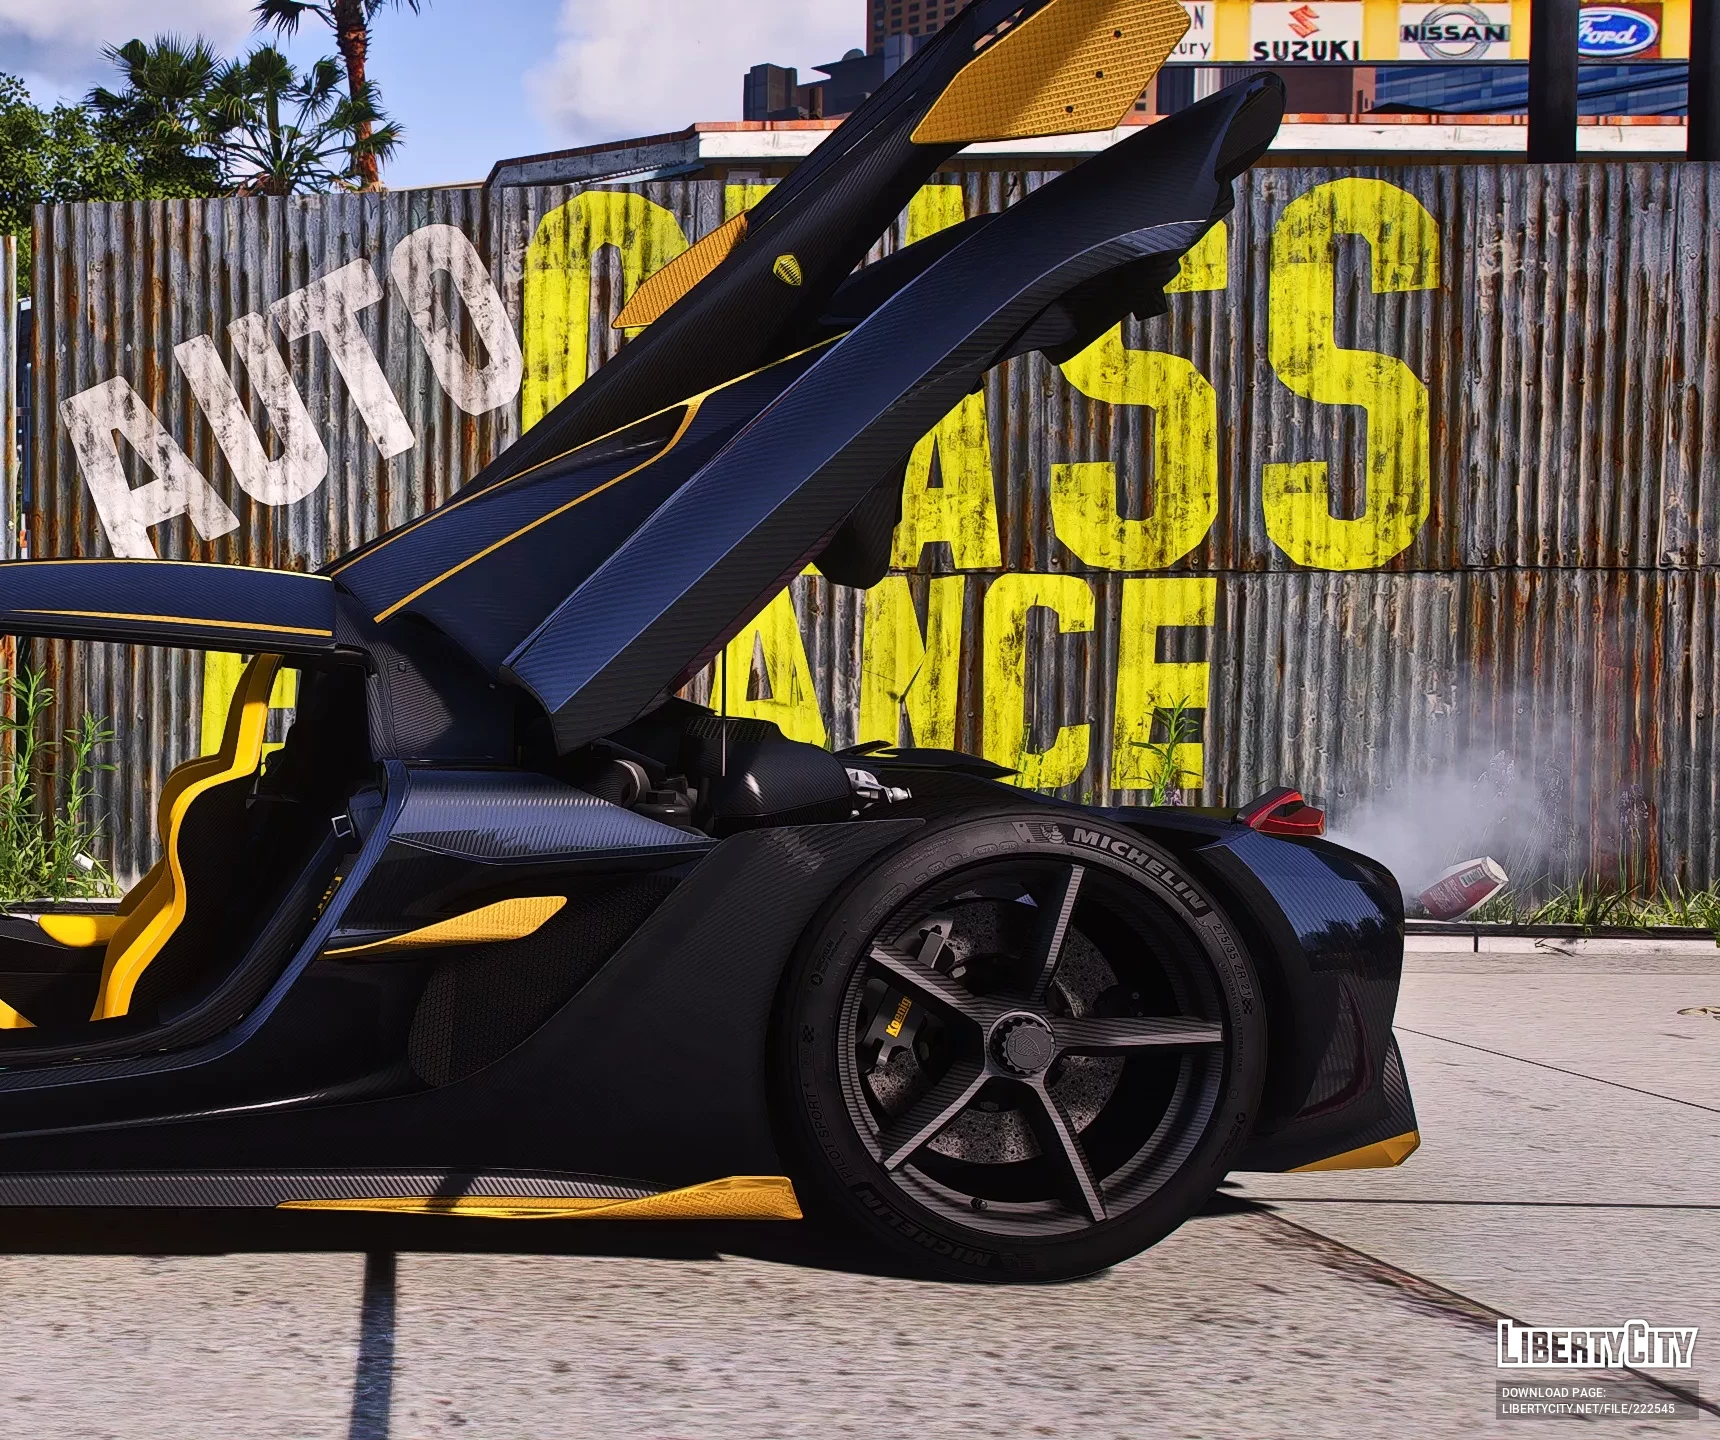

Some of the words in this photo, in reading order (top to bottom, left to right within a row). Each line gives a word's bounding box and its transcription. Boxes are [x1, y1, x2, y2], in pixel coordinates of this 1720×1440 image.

[1253, 40, 1359, 60] SUZUKI
[1403, 25, 1506, 41] NISSAN
[1579, 14, 1637, 44] Ford
[59, 224, 524, 558] AUTO
[1072, 828, 1207, 911] MICHELIN
[1212, 921, 1239, 960] 275/35
[1233, 962, 1246, 979] ZR
